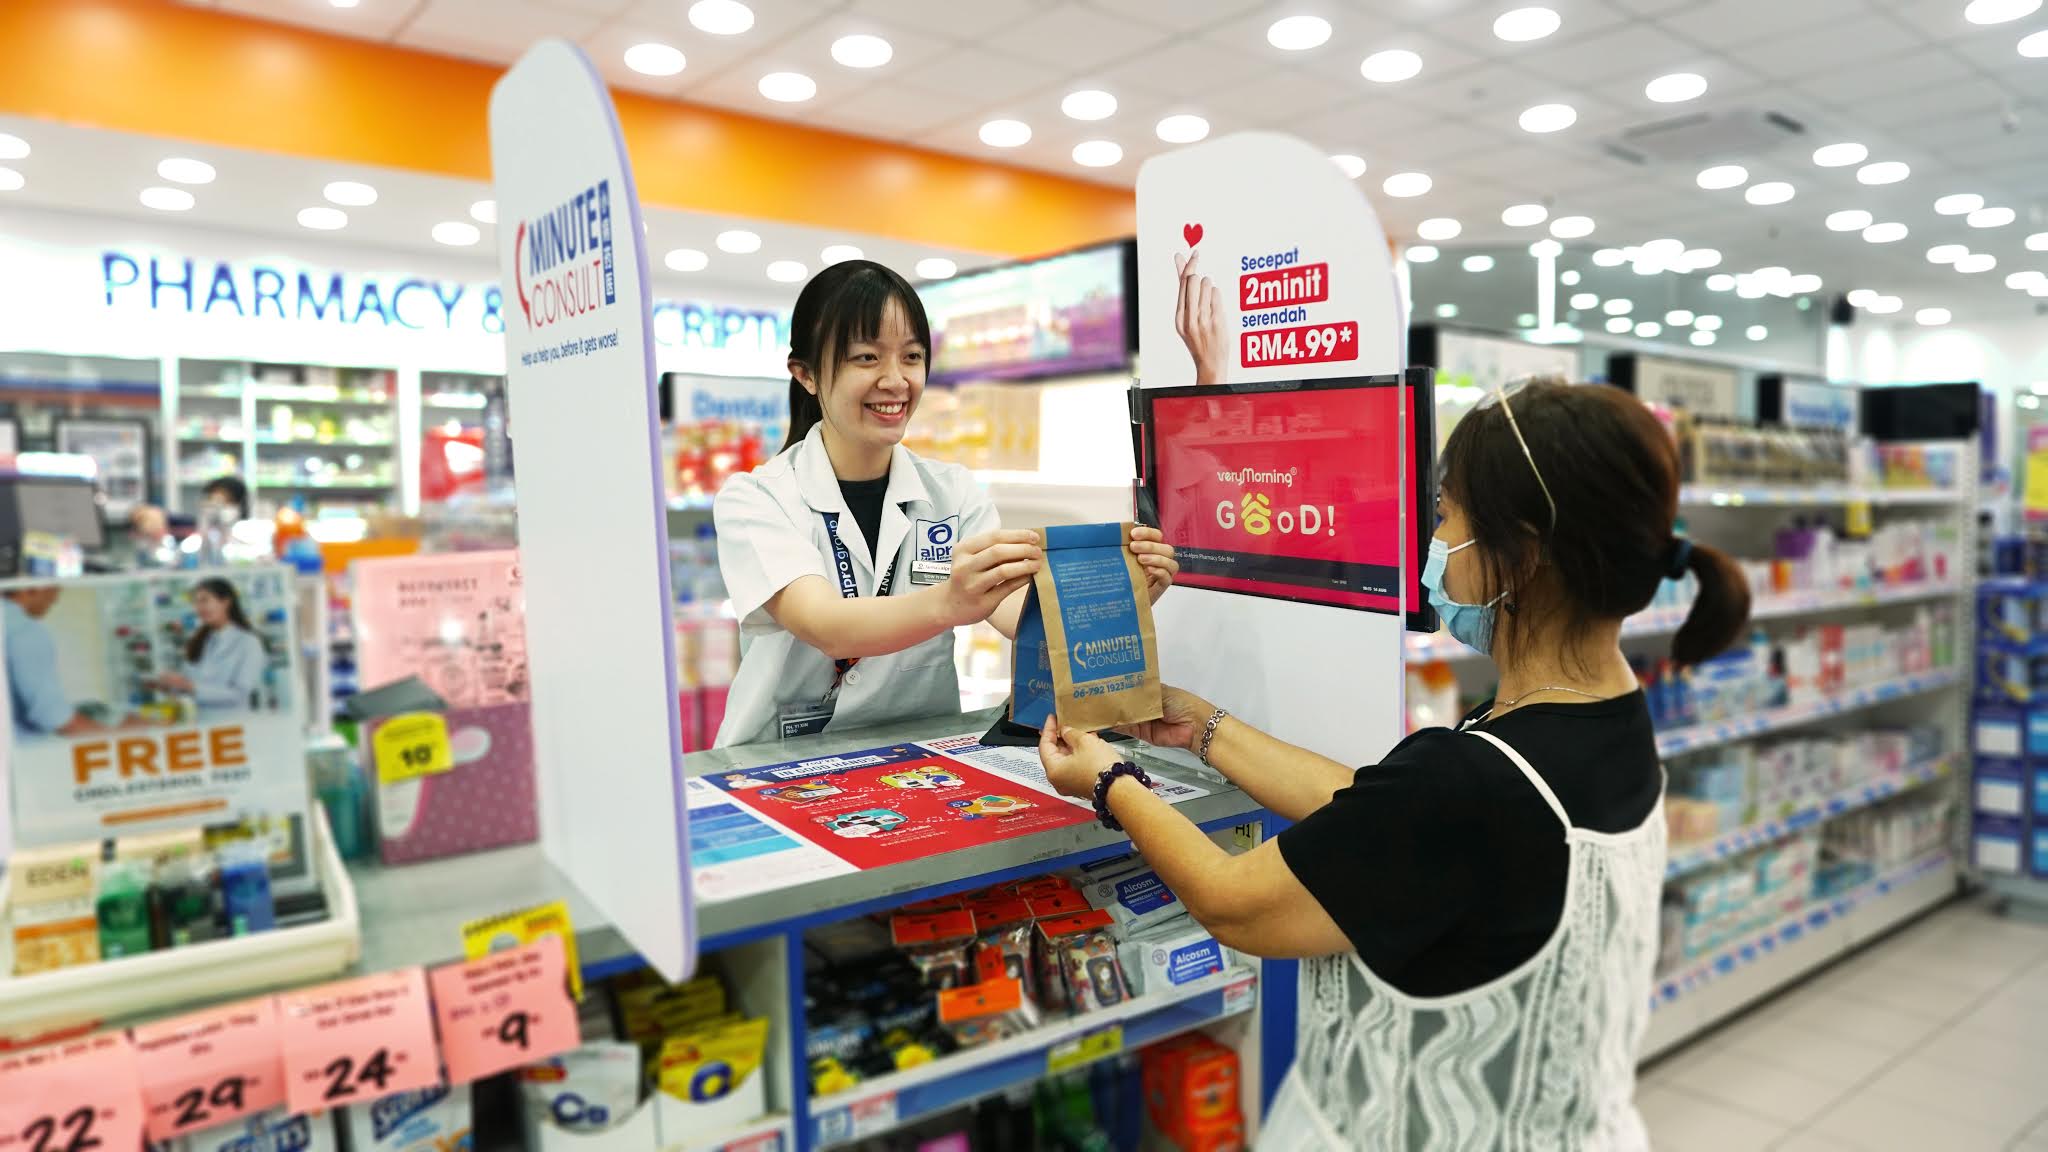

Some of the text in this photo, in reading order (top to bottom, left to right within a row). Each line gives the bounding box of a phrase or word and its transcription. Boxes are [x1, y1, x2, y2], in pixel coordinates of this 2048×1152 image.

[528, 187, 598, 277] MINUTE
[1241, 248, 1299, 271] Secepat
[103, 252, 464, 329] PHARMACY
[532, 260, 601, 328] CONSULT
[1245, 268, 1322, 305] 2minit
[1242, 306, 1307, 328] serendah
[561, 340, 578, 357] before
[584, 336, 597, 356] gets
[920, 546, 952, 560] alpr
[1086, 636, 1131, 656] MINUTE
[1088, 650, 1134, 668] CONSULT
[1073, 682, 1124, 699] 06-792 1923
[72, 725, 249, 785] FREE
[1123, 878, 1155, 895] Alcosm
[1175, 947, 1211, 965] Alcosm
[498, 1011, 530, 1050] 9
[323, 1048, 395, 1100] 24
[174, 1076, 246, 1127] 29
[22, 1106, 102, 1152] 22
